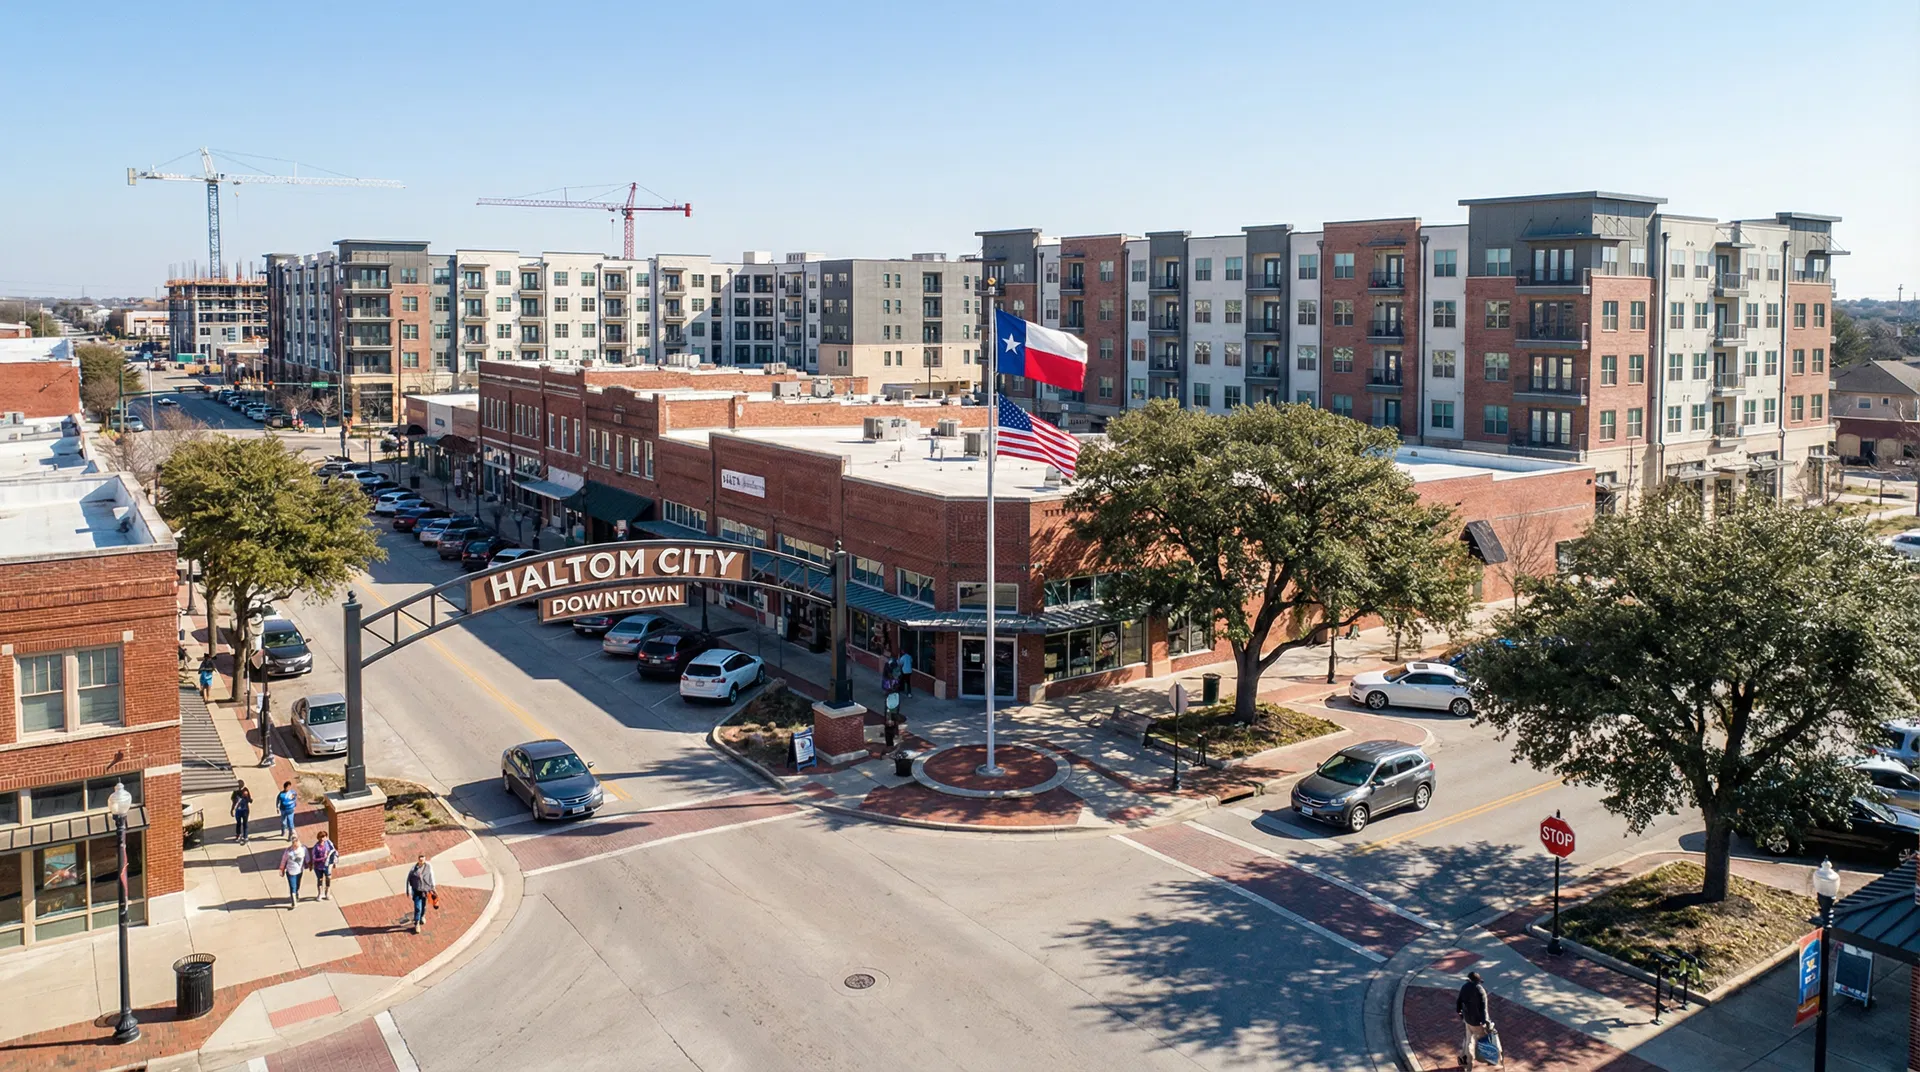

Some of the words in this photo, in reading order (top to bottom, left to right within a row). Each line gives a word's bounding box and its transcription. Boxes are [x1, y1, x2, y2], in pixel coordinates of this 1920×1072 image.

[490, 549, 645, 602] HALTOM
[658, 548, 737, 576] CITY
[552, 586, 680, 616] DOWNTOWN
[1542, 826, 1573, 847] STOP
